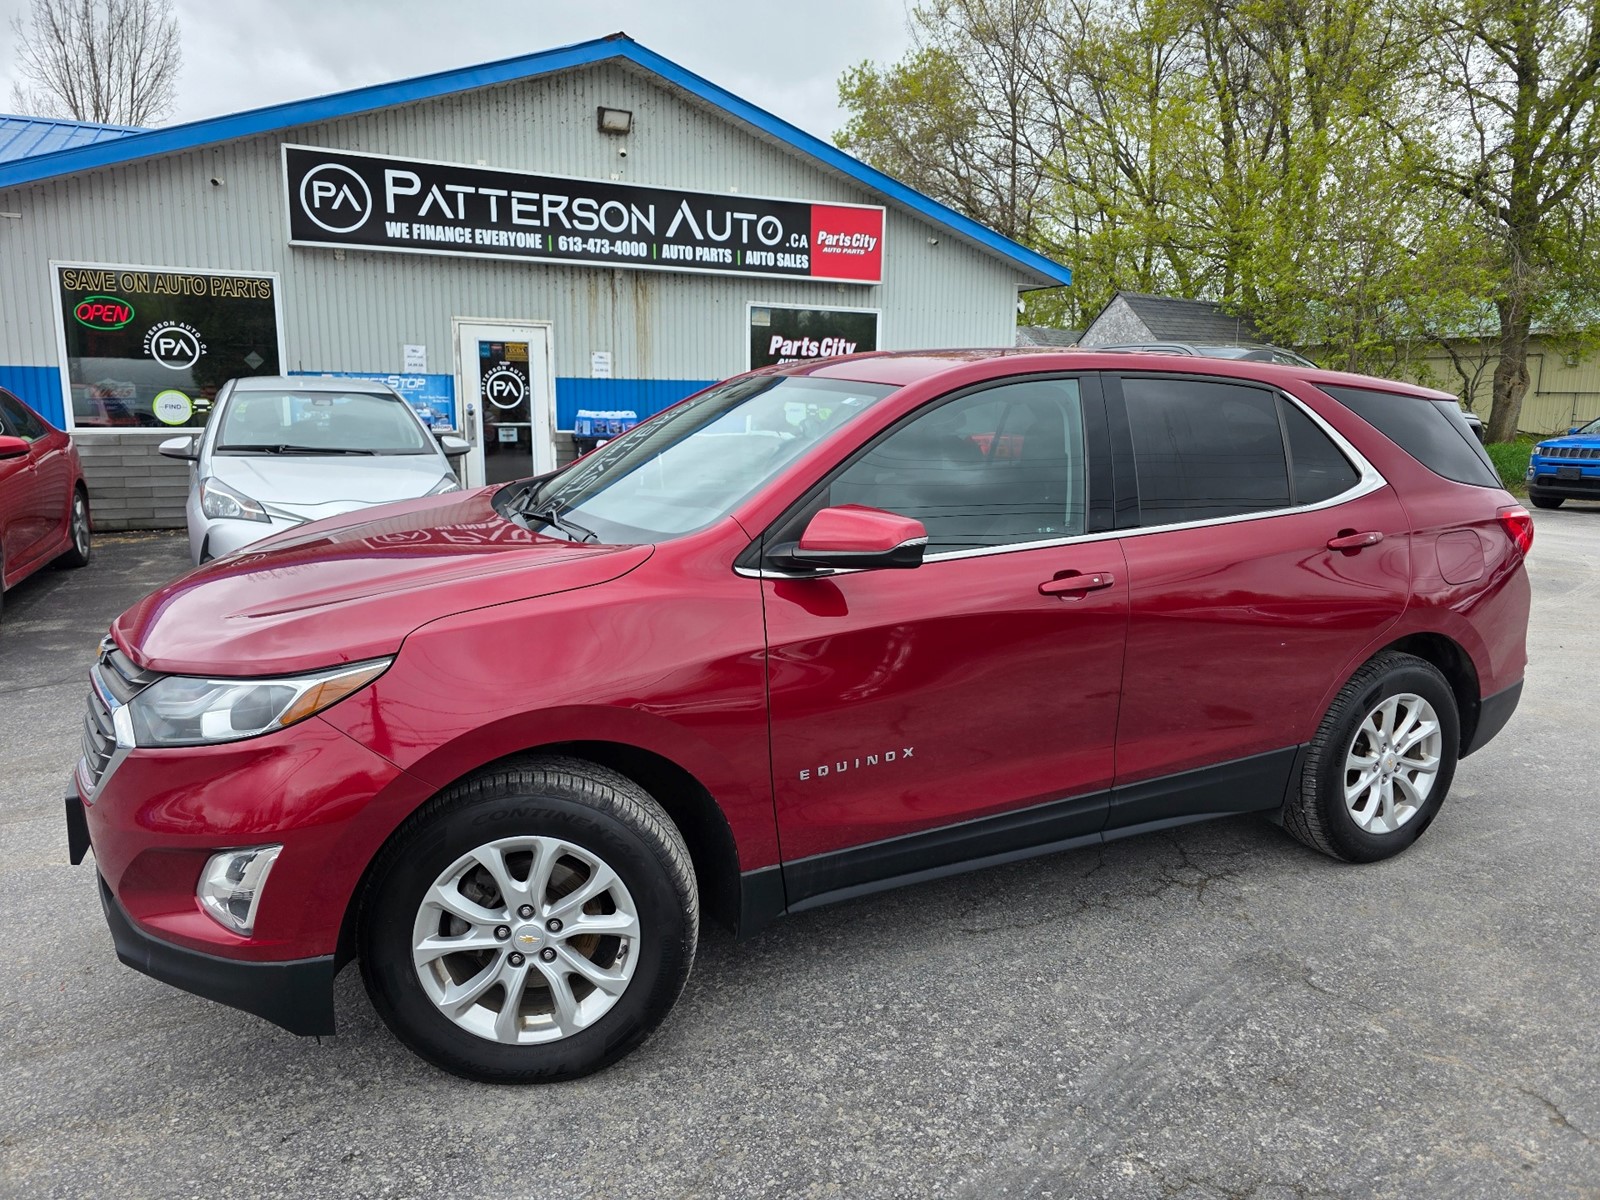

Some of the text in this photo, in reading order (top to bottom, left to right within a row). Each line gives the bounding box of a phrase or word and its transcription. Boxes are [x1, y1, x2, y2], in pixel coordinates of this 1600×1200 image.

[312, 180, 362, 212] PA
[384, 169, 655, 236] PATTERSON
[385, 221, 542, 249] WE FINANCE EVERYONE
[558, 236, 648, 258] 613-473-4000
[662, 244, 732, 264] AUTO PARTS
[745, 250, 809, 269] AUTO SALES
[63, 270, 271, 299] SAVE ON AUTO PARTS
[77, 303, 129, 323] OPEN
[143, 320, 175, 354] PATTERSON
[179, 322, 201, 338] AUTO
[159, 338, 194, 356] PA
[481, 365, 507, 395] PATTERSON
[509, 367, 526, 381] AUTO
[493, 380, 519, 397] PA
[800, 747, 914, 780] EQUINOX
